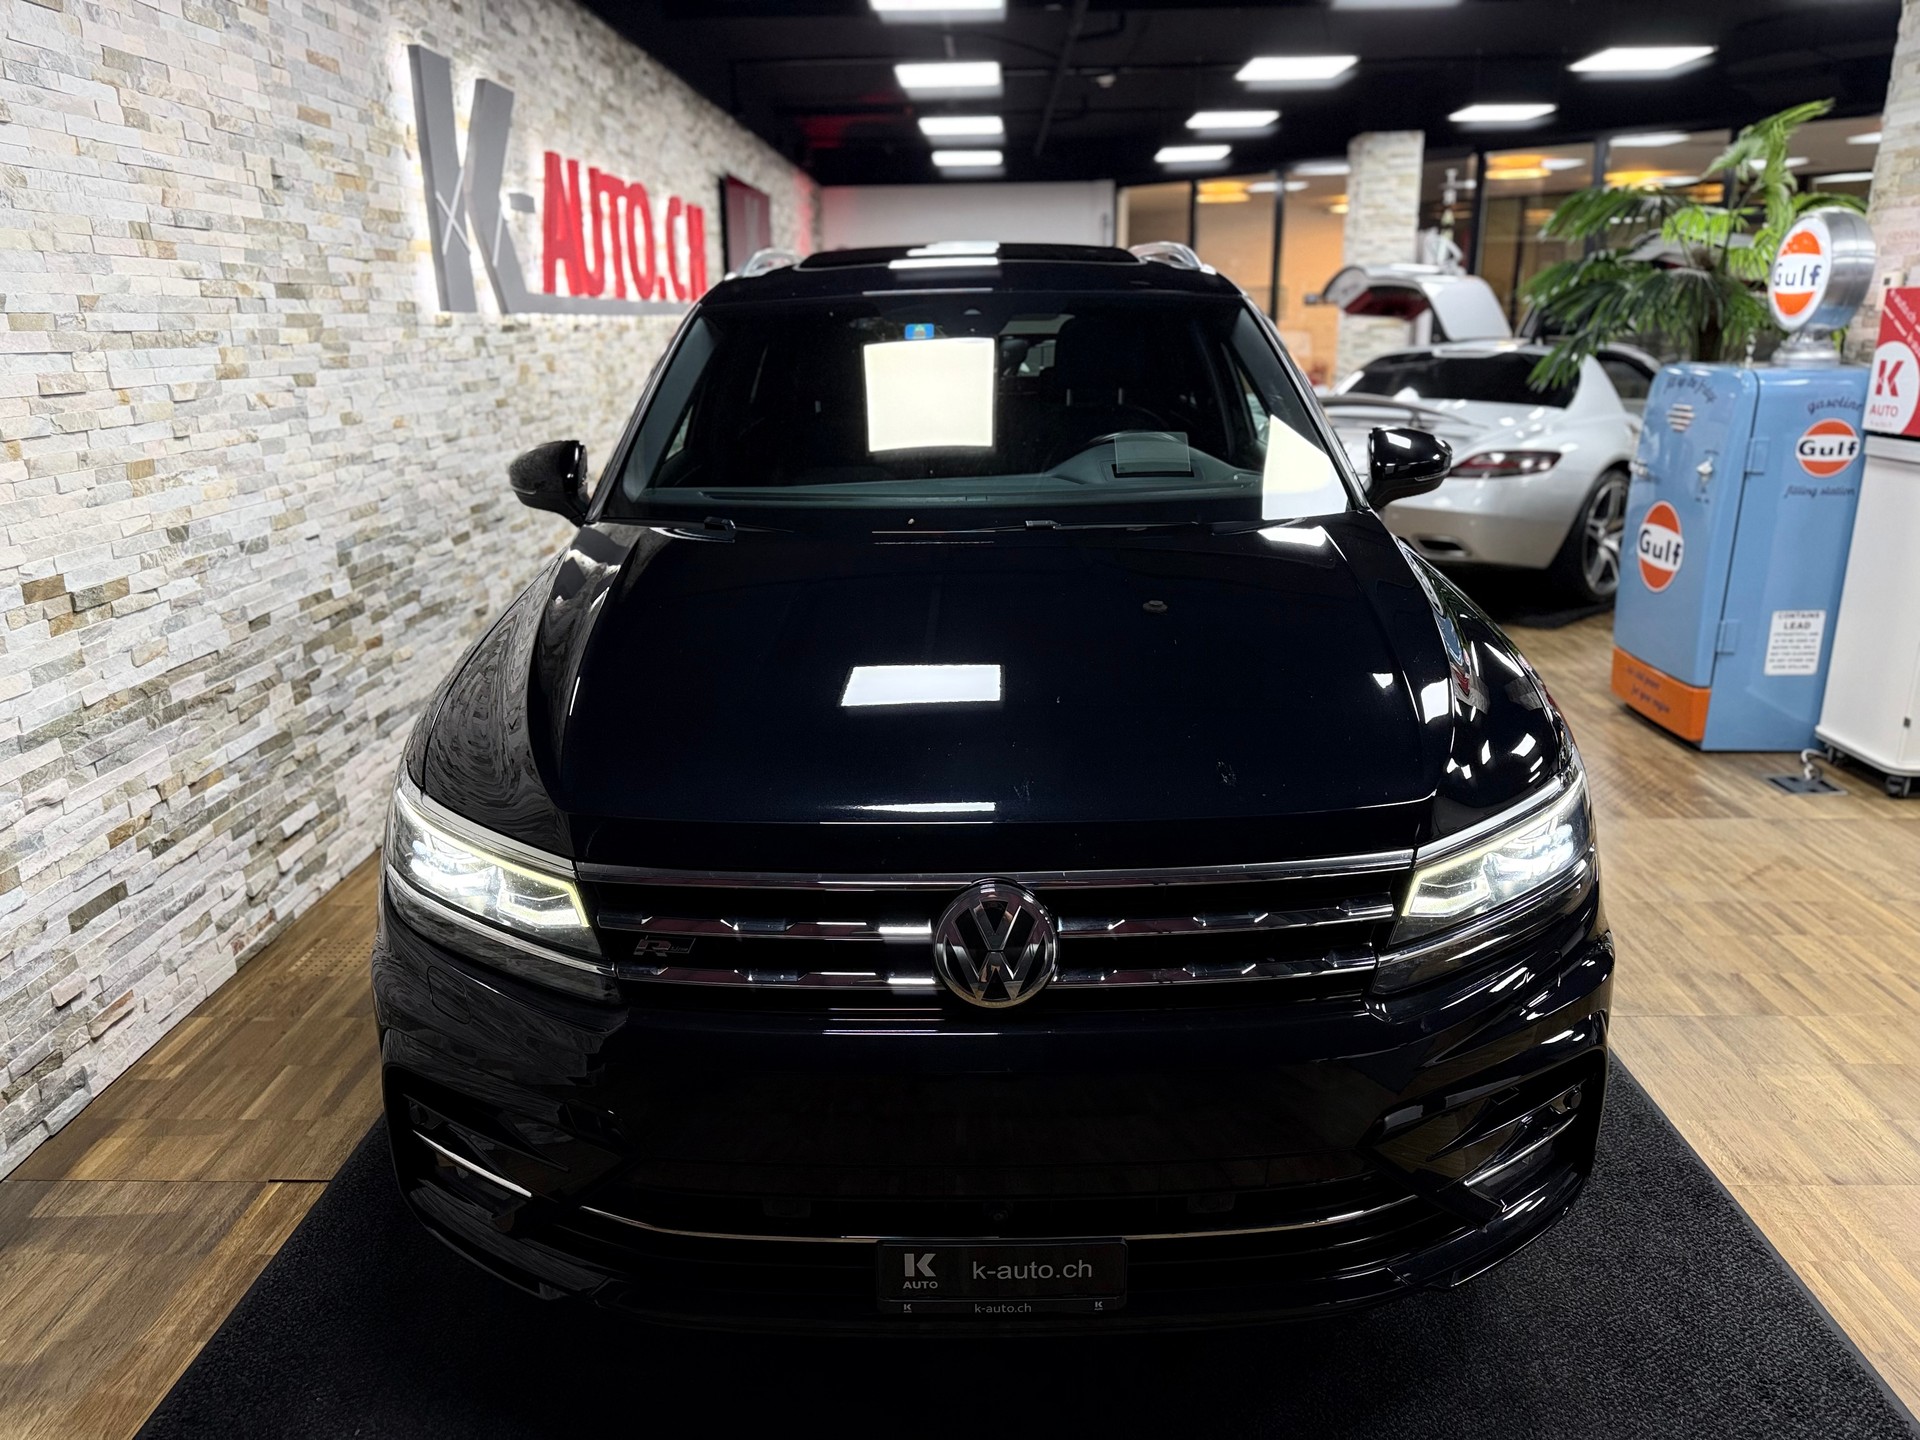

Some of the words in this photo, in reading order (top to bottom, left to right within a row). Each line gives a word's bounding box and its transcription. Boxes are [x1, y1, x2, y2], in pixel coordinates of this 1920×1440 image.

[1875, 360, 1904, 397] K
[1869, 403, 1899, 417] AUTO
[1798, 440, 1858, 456] Gulf
[1640, 529, 1681, 566] Gulf
[1783, 621, 1812, 630] LEAD
[904, 1253, 937, 1277] K
[972, 1259, 1093, 1280] k-auto.ch
[902, 1281, 938, 1289] AUTO
[974, 1303, 1032, 1313] k-auto.ch
